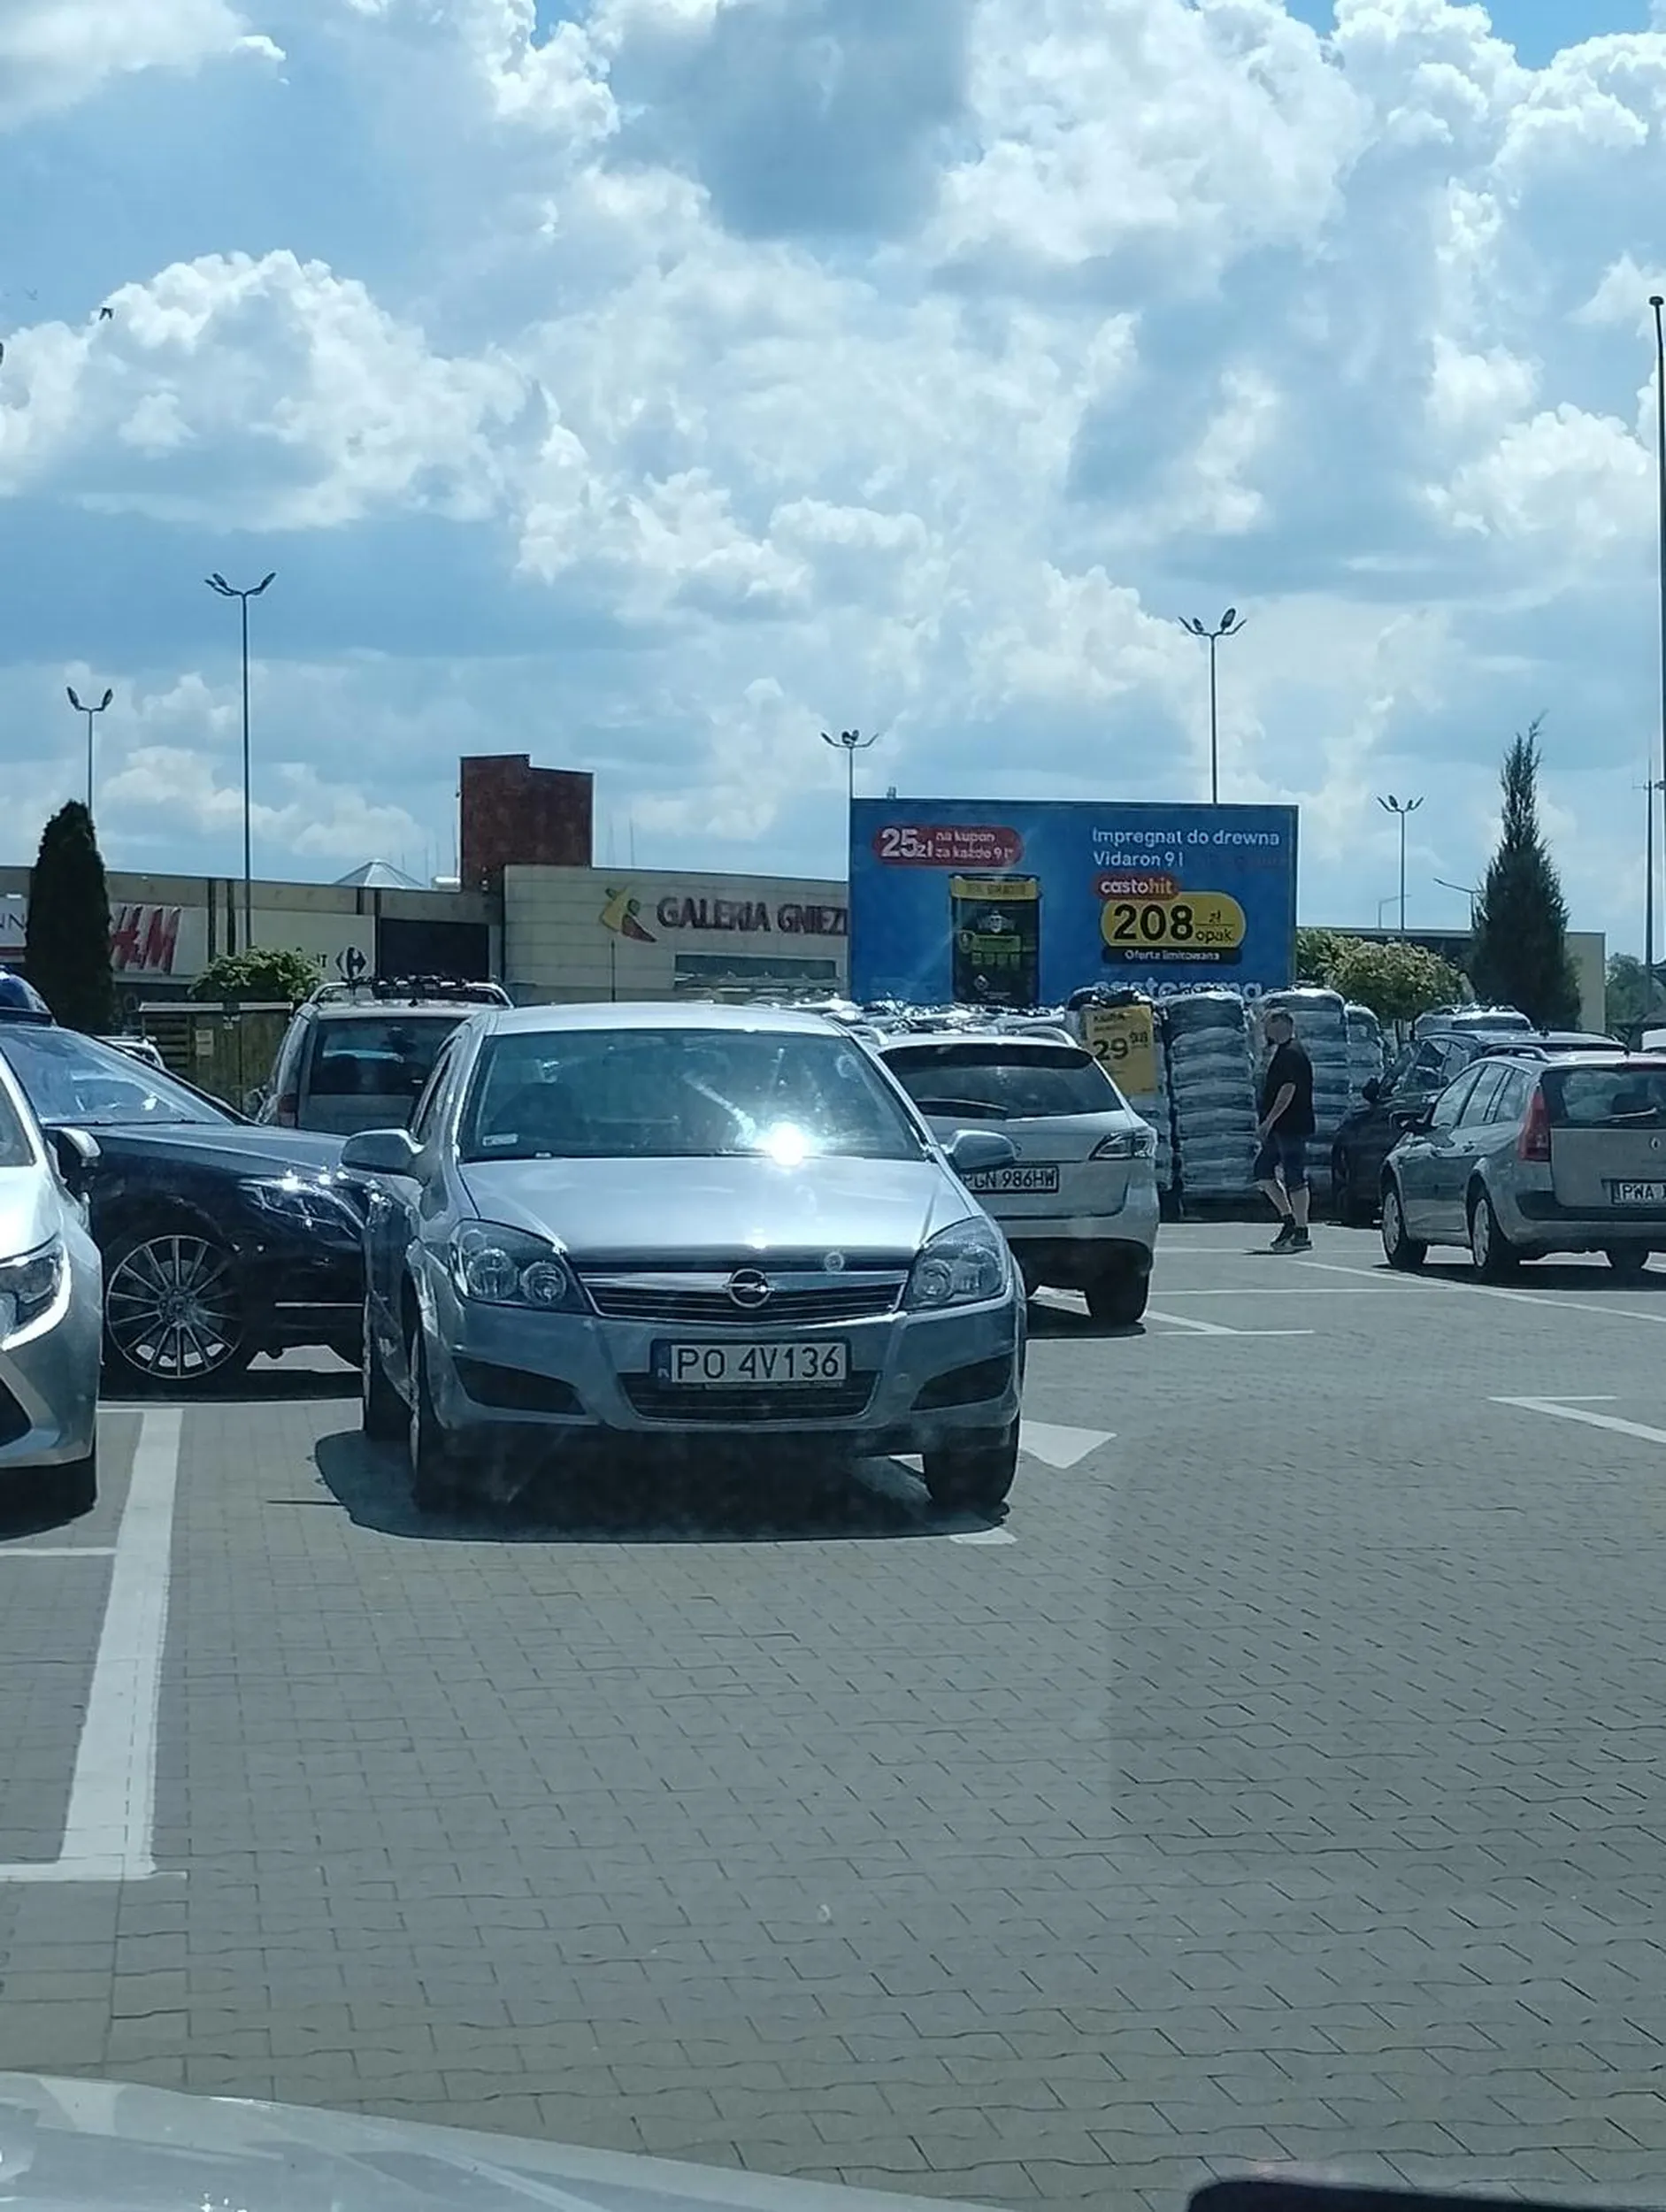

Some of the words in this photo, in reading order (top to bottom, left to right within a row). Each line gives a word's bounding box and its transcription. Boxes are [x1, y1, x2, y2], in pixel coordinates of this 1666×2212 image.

[1092, 826, 1182, 847] Impregnat
[1186, 830, 1209, 845] do
[1212, 830, 1279, 846] drewna
[1093, 851, 1161, 866] Vidaron
[1164, 851, 1175, 866] 9
[1100, 877, 1173, 895] castohit
[656, 897, 772, 932] GALERIA
[1113, 903, 1194, 941] 208
[1093, 1037, 1129, 1061] 29
[1002, 1170, 1056, 1188] 986HW
[1623, 1184, 1654, 1200] PWA
[677, 1347, 726, 1379] PO
[738, 1345, 839, 1379] 4V136
